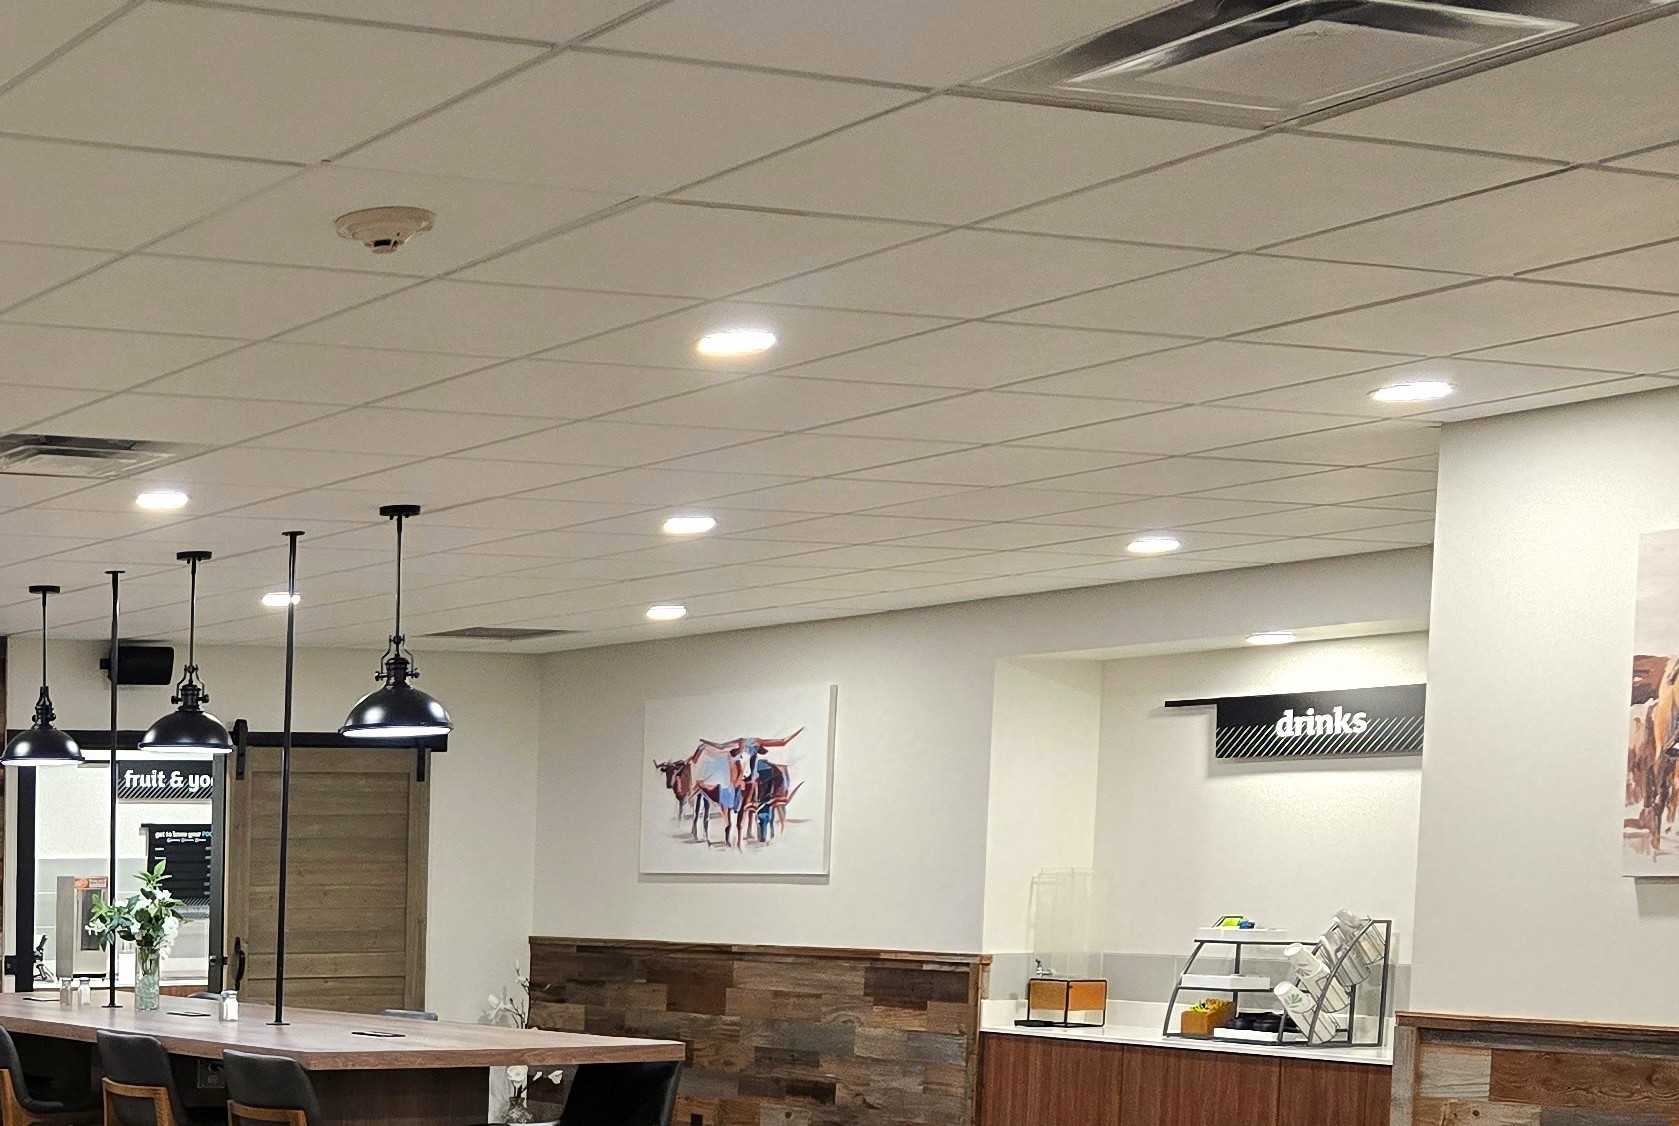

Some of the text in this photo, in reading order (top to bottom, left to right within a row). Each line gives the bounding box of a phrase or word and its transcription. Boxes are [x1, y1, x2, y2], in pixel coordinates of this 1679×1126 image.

[1275, 705, 1368, 737] drinks
[124, 769, 213, 792] fruit & yo
